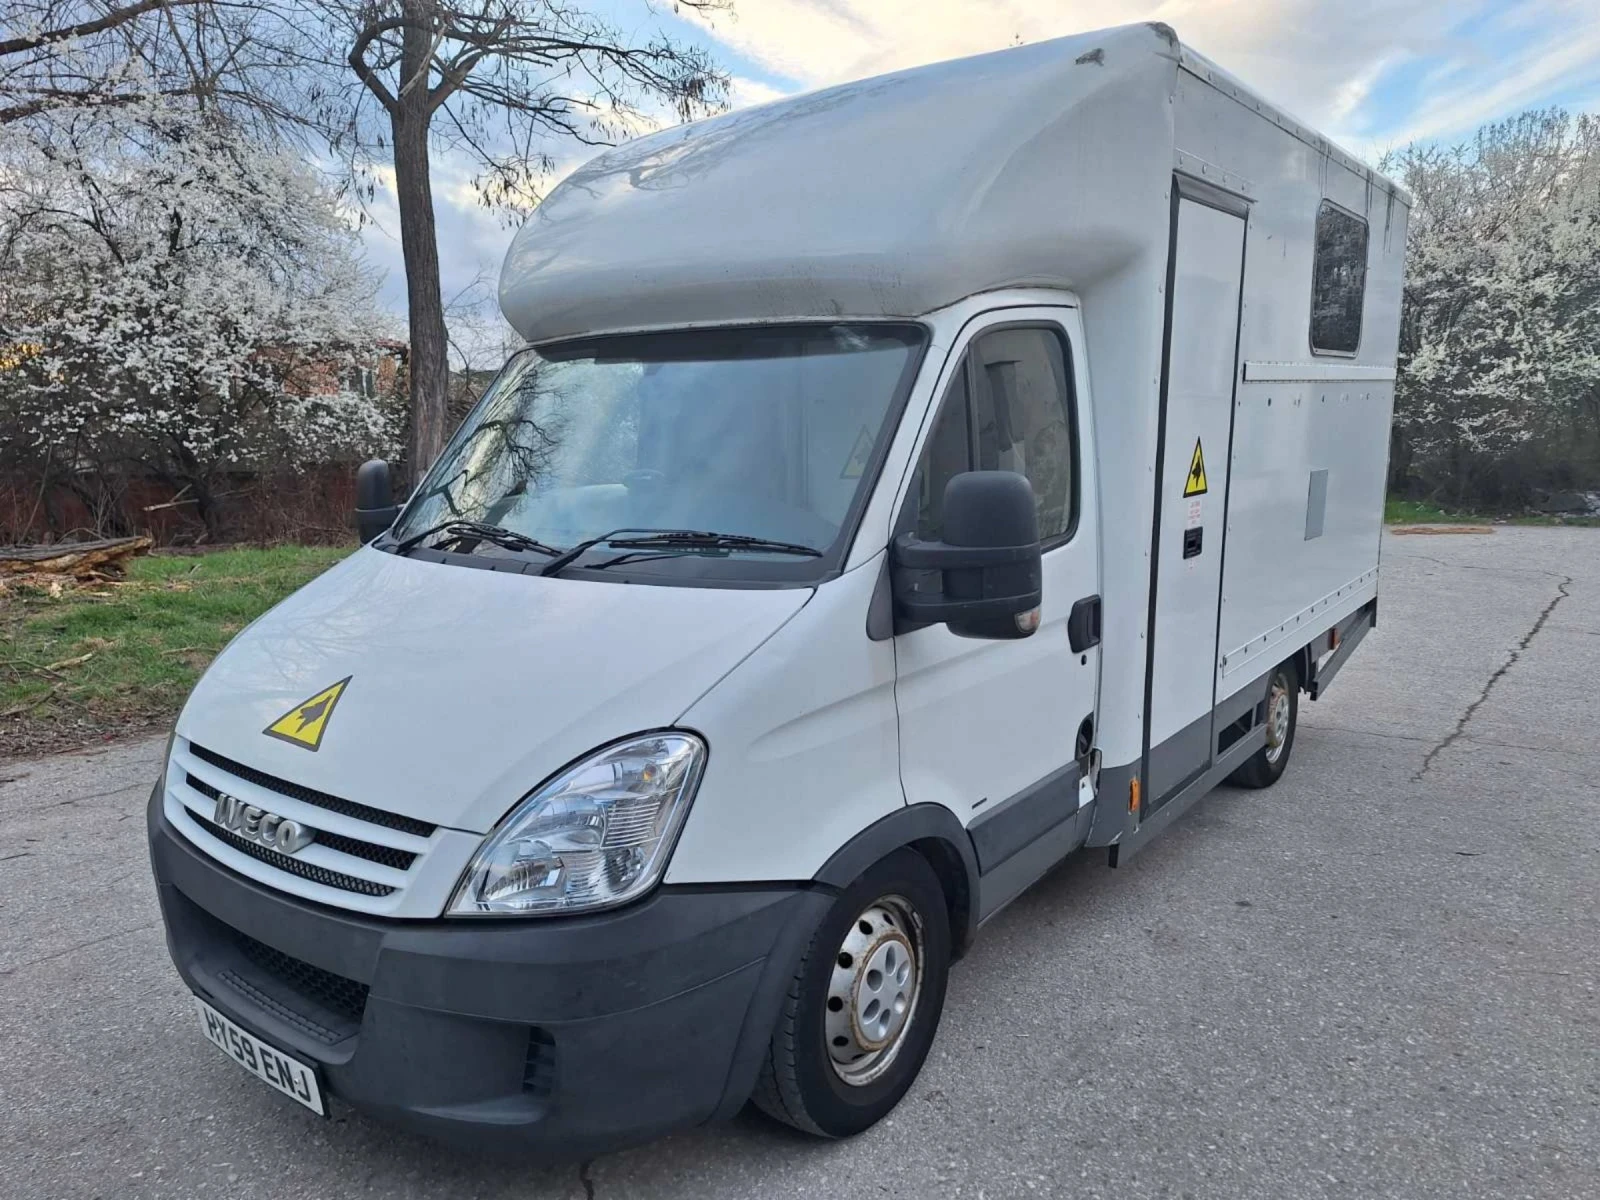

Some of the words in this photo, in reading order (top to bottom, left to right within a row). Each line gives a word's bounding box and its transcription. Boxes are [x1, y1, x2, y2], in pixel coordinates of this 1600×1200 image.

[213, 793, 305, 854] IVECO
[203, 1007, 258, 1071] HY59
[259, 1047, 311, 1103] ENJ
